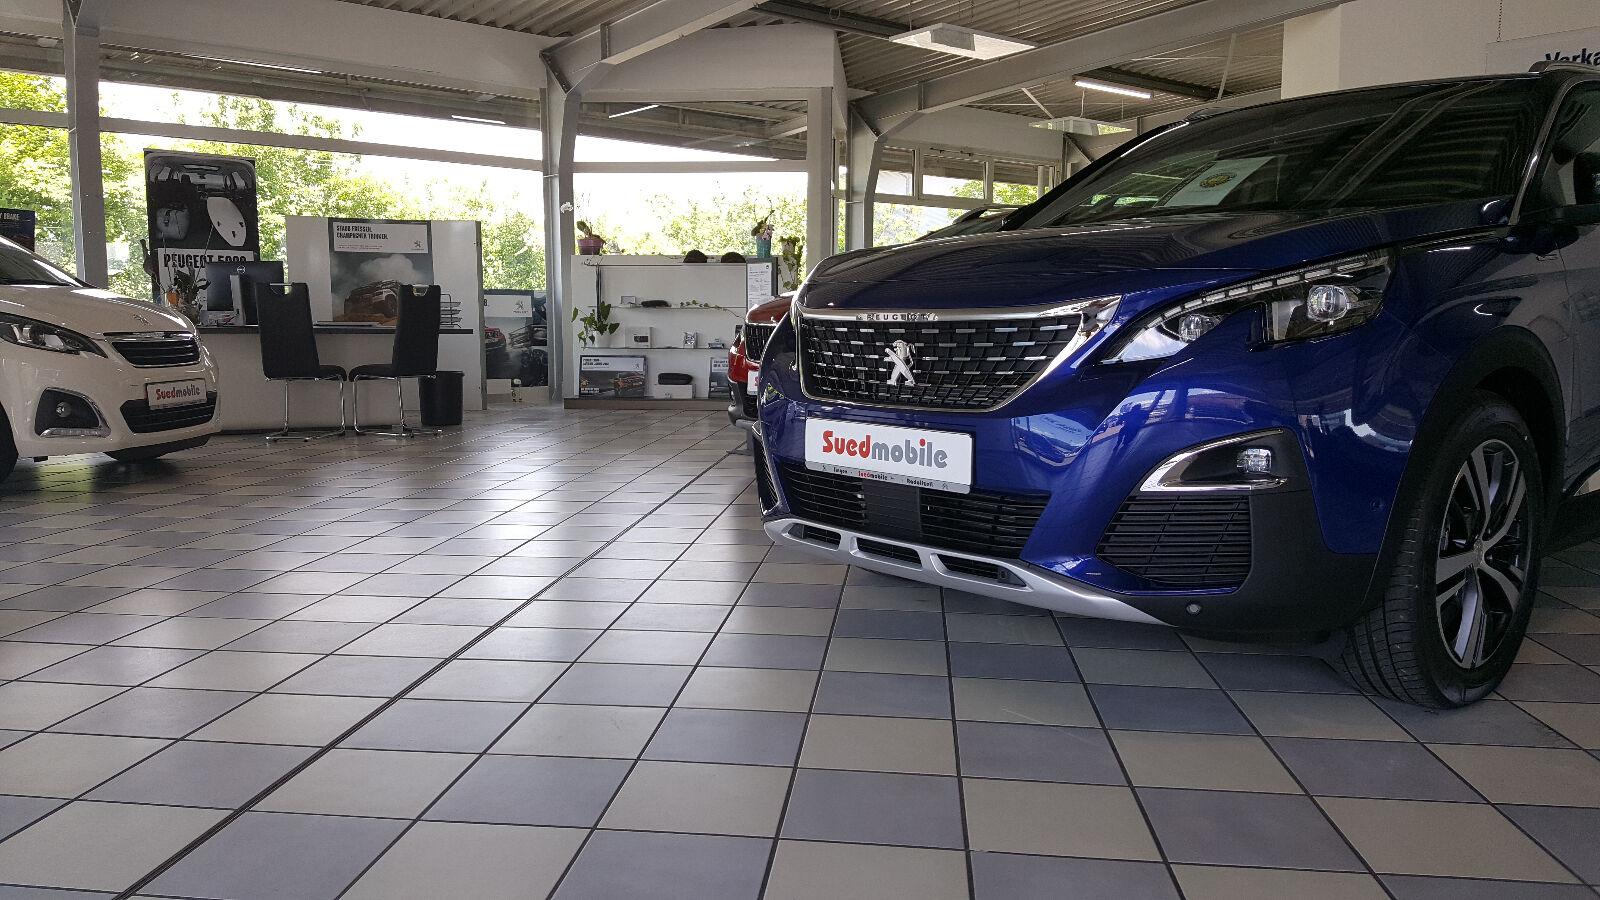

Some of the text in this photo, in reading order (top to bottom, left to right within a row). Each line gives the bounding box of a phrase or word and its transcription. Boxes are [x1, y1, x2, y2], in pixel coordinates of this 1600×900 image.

[163, 253, 214, 268] PEUGEOT
[155, 383, 200, 401] Suedmobile
[822, 429, 948, 469] Suedmobile
